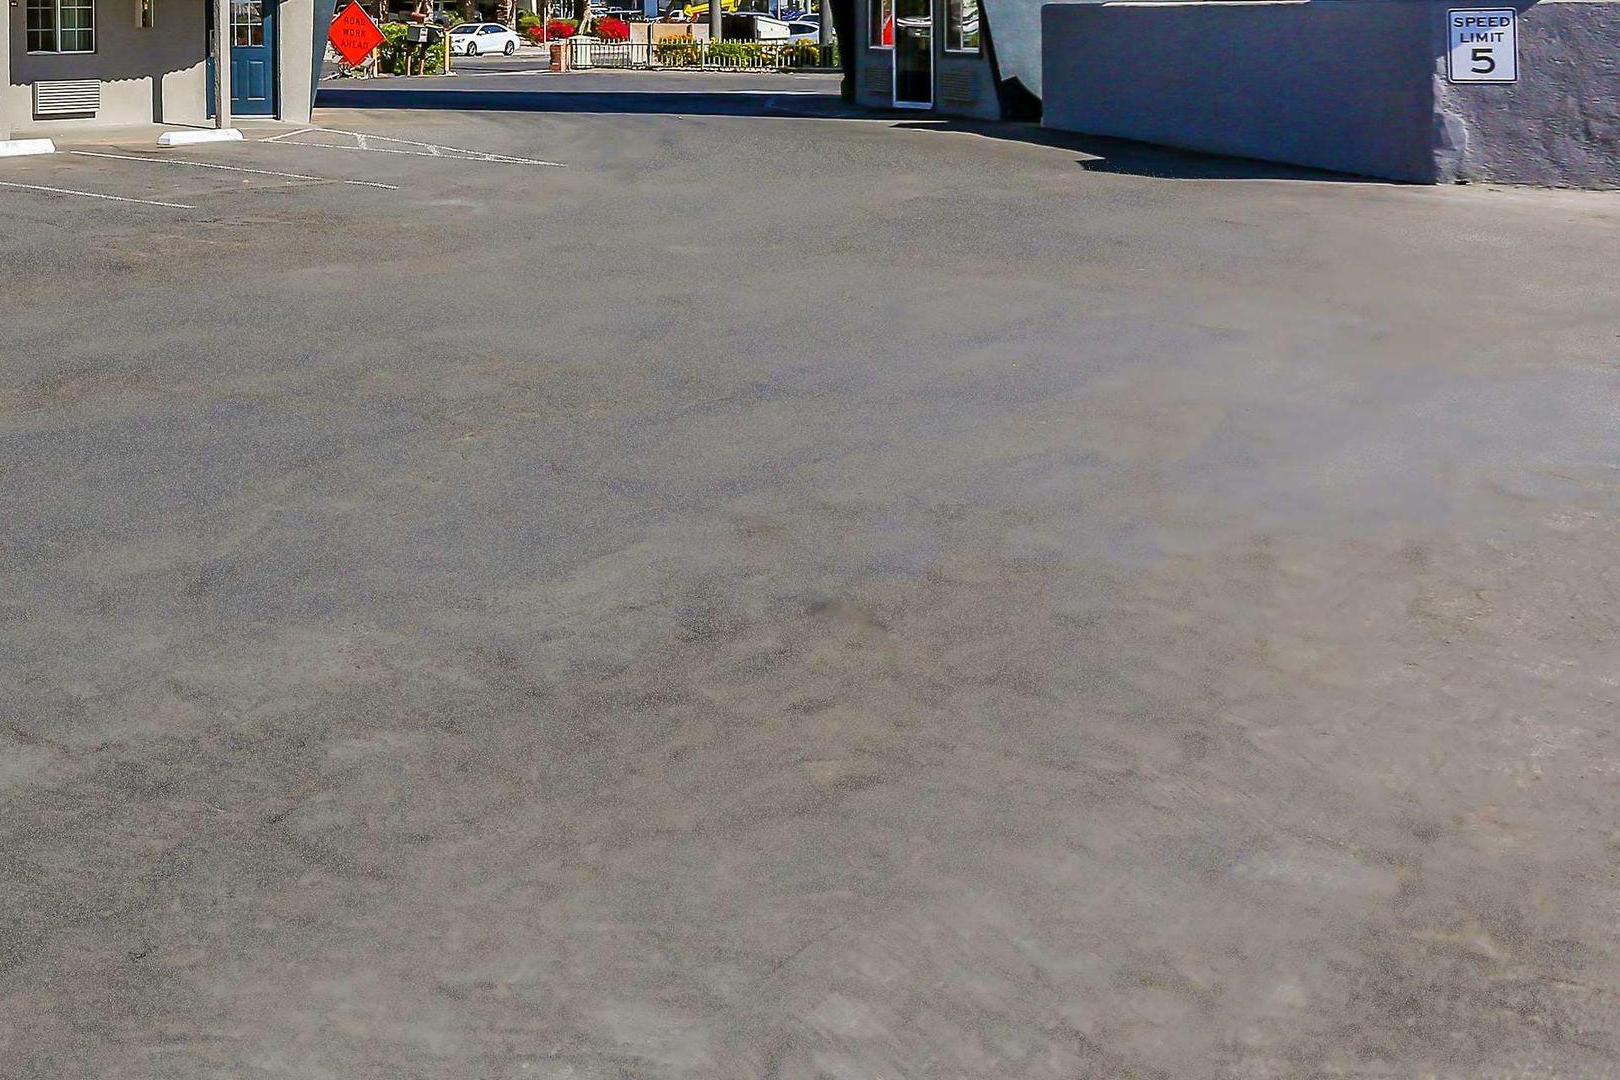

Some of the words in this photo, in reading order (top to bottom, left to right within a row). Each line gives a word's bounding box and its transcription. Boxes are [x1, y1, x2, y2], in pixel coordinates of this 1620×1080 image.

[345, 17, 366, 25] ROAD
[1453, 16, 1510, 27] SPEED
[343, 29, 366, 37] WORK
[1460, 32, 1504, 43] LIMIT
[340, 39, 369, 49] AHEAD
[1471, 48, 1495, 74] 5
